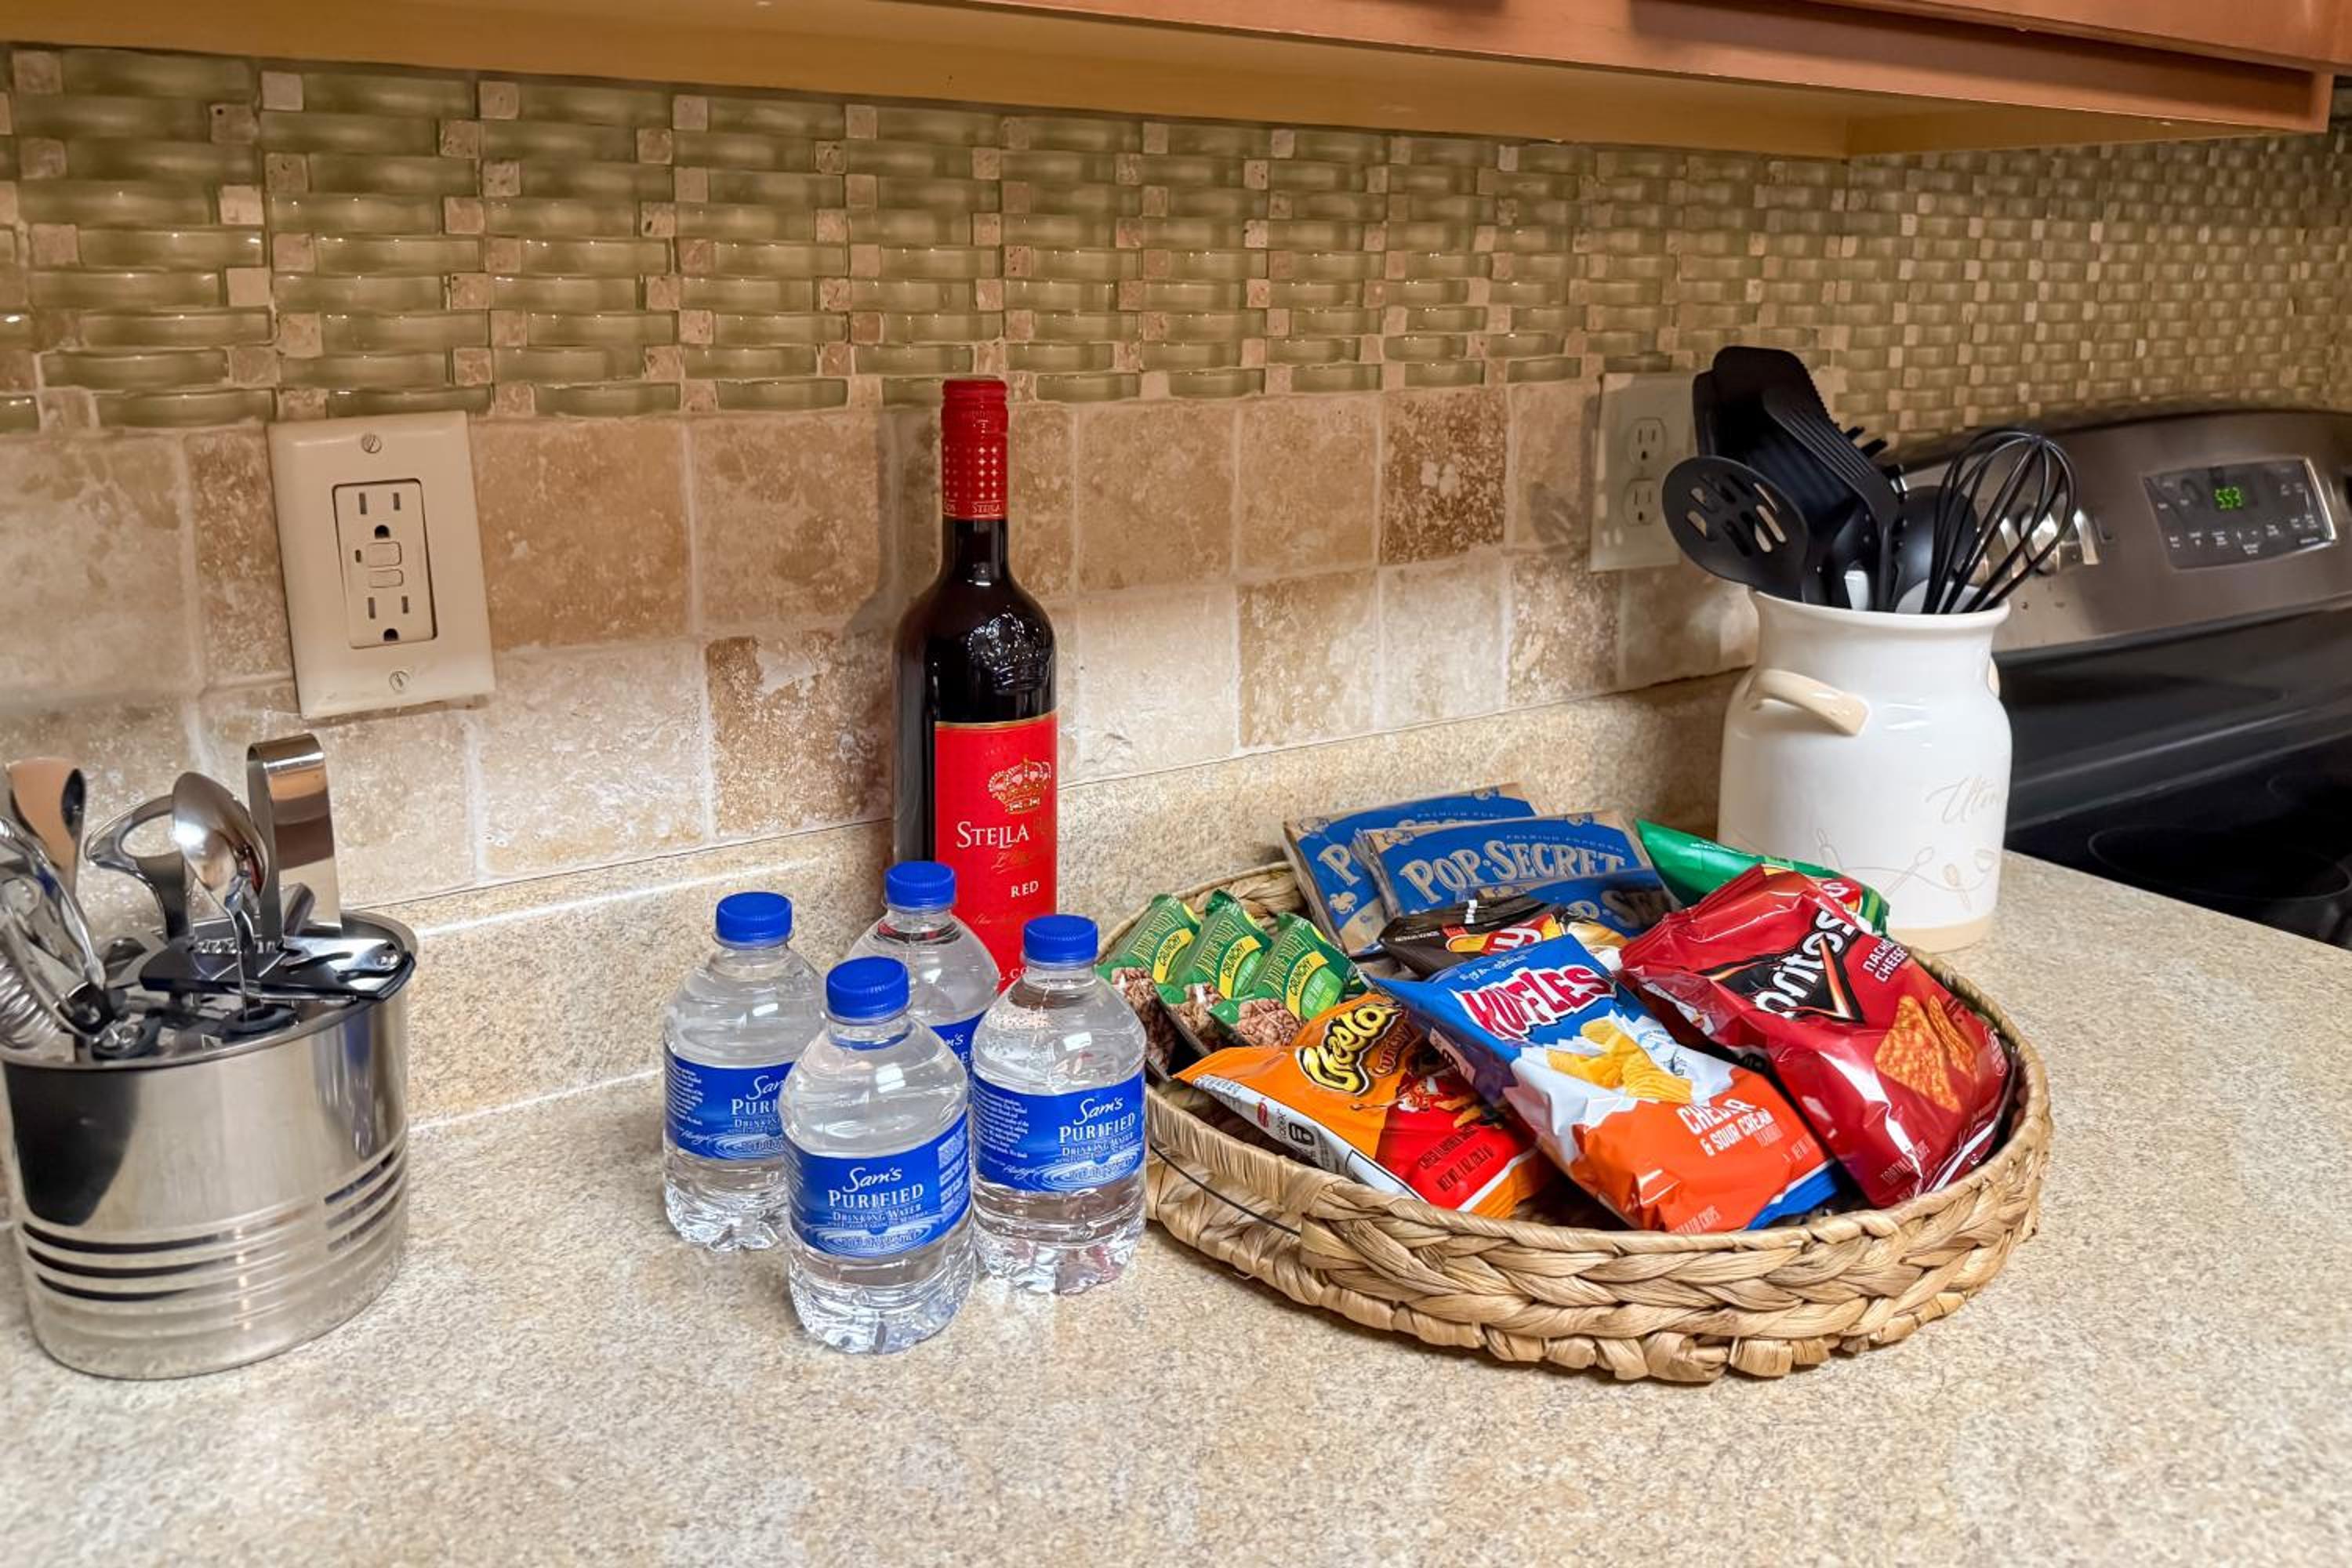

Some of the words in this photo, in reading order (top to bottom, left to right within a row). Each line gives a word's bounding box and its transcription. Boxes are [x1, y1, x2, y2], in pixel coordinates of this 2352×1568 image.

[956, 821, 1029, 850] STELLA
[1010, 880, 1040, 898] RED
[1289, 958, 1314, 996] CRUNCHY
[1875, 946, 1908, 983] CHEESE
[731, 1098, 777, 1116] PURI
[1073, 1098, 1124, 1126] Sam's
[1058, 1112, 1137, 1145] PURIFIED
[1709, 1123, 1741, 1150] SOUR
[842, 1167, 902, 1193] Sam's
[827, 1182, 925, 1209] PURIFIED
